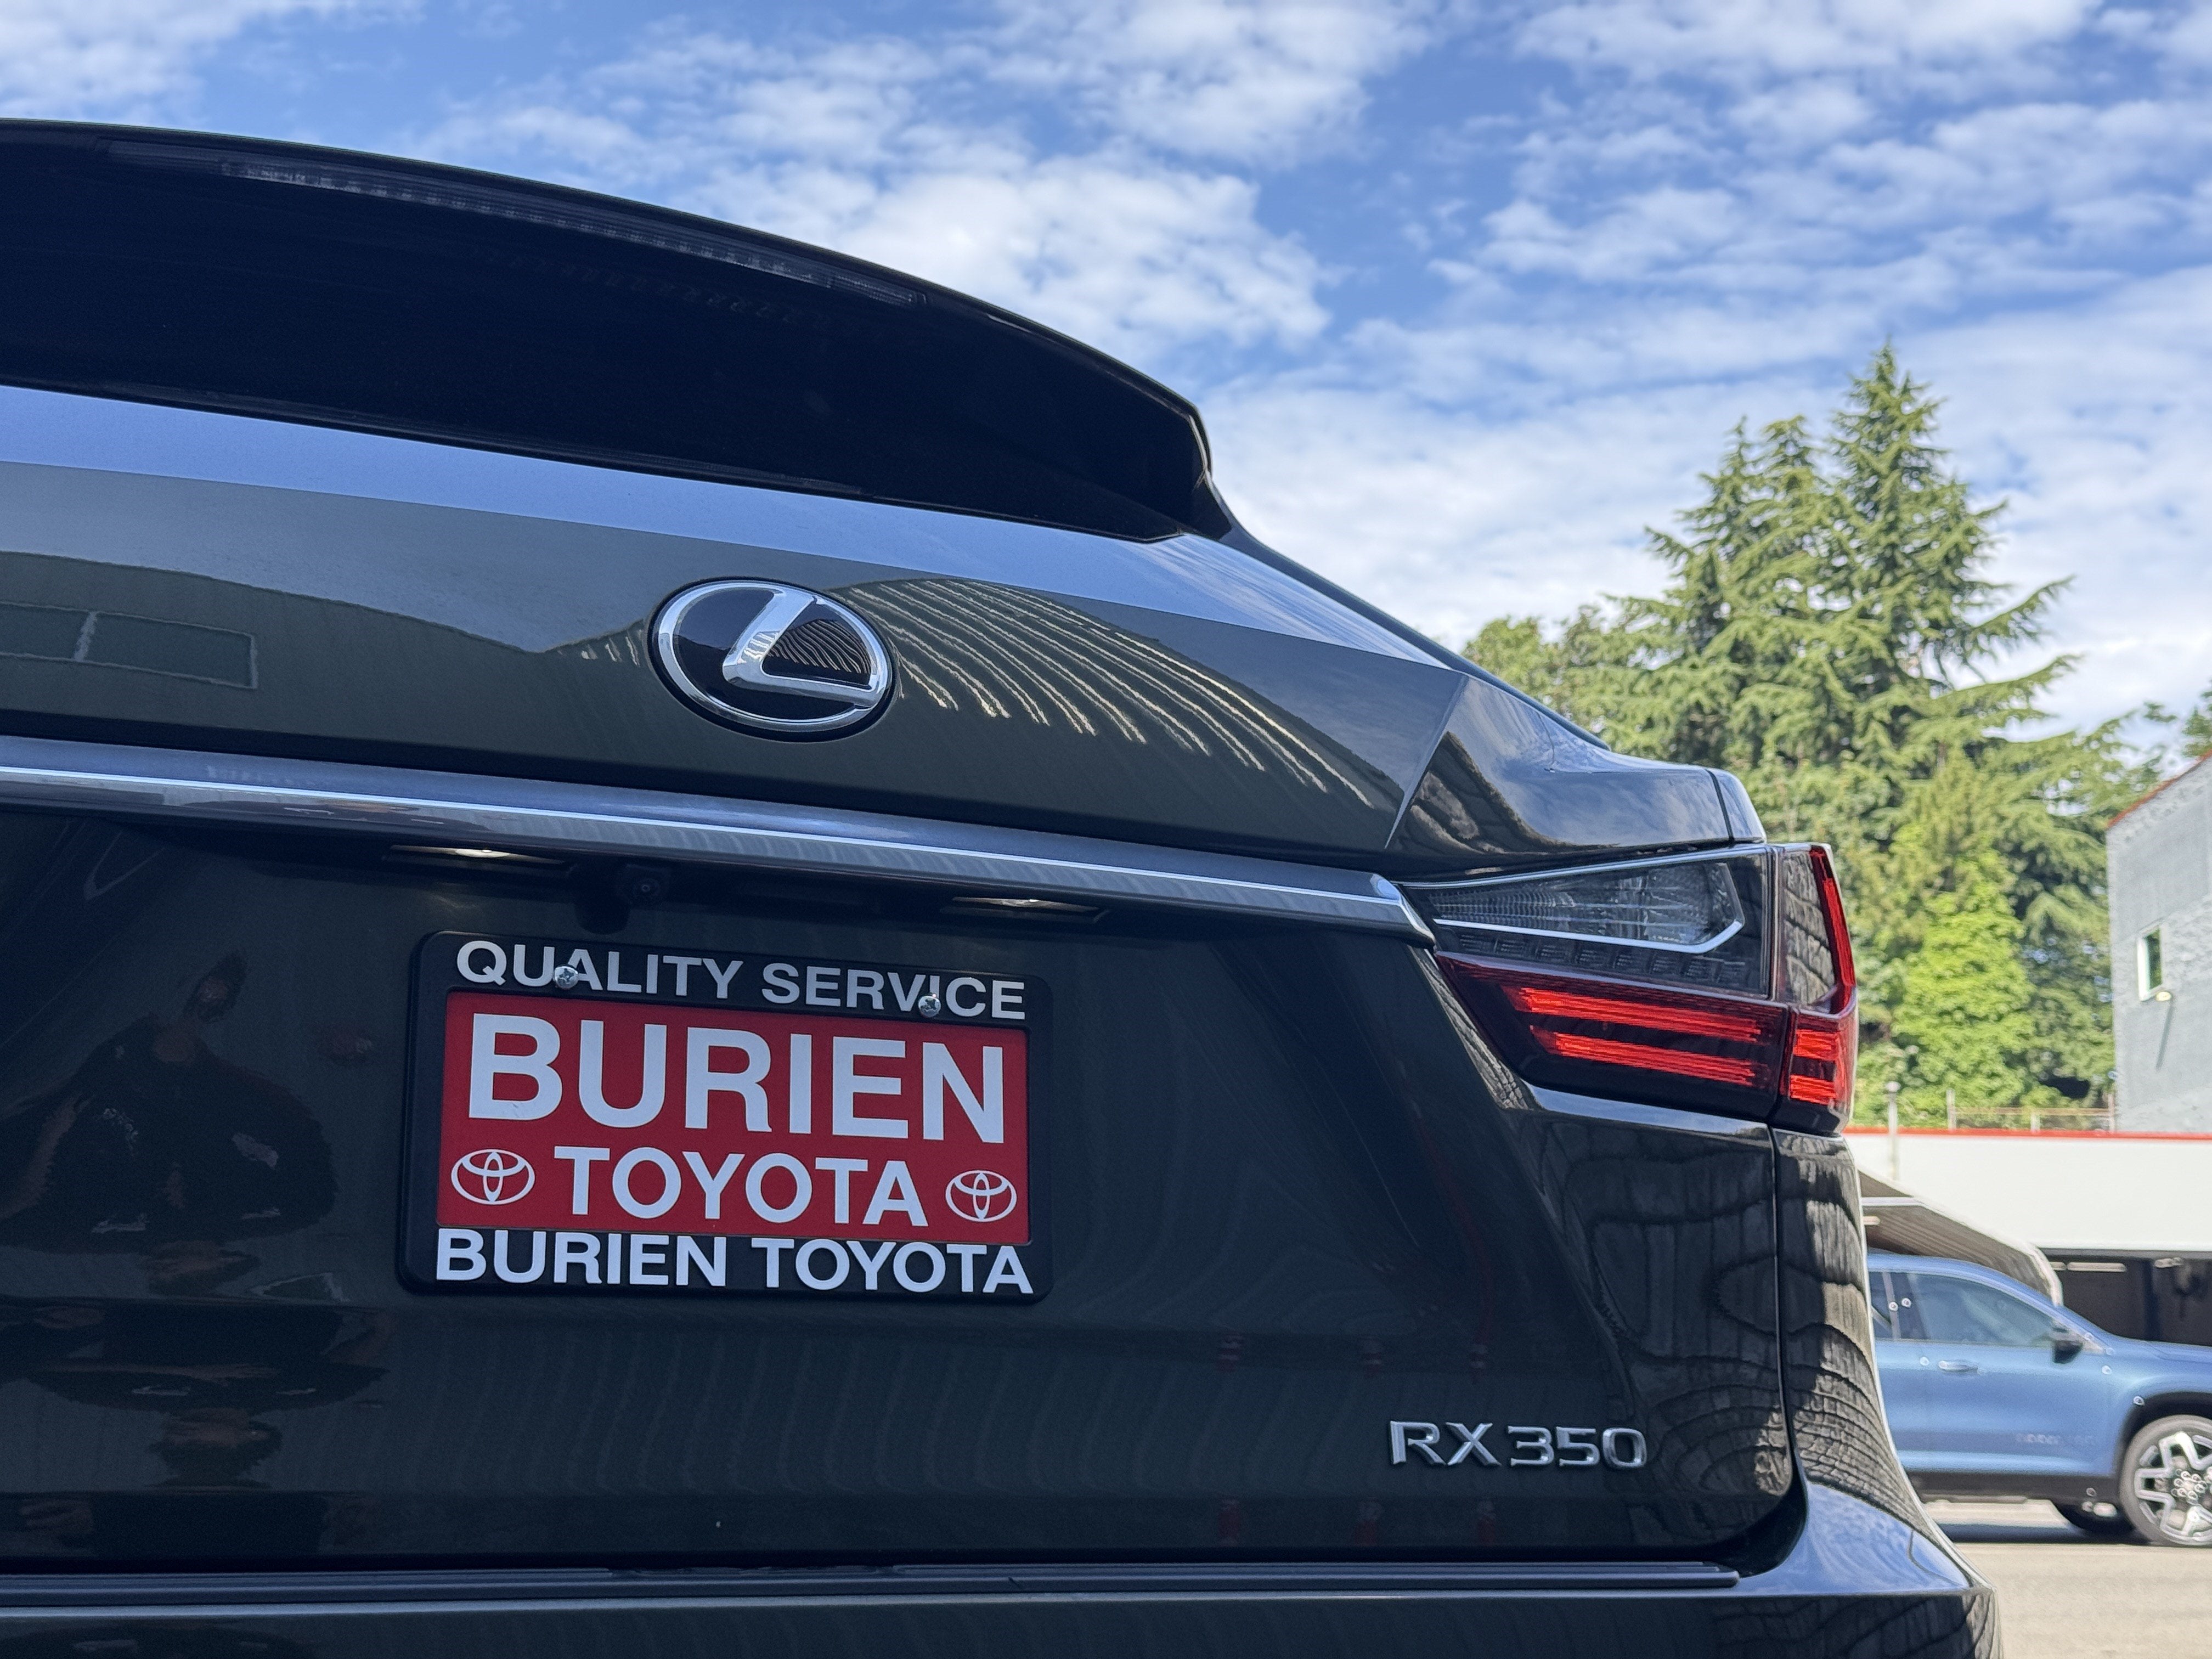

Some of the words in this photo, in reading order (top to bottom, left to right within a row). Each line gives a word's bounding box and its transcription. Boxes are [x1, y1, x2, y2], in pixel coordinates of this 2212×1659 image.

[456, 940, 743, 999] QUALITY
[761, 963, 1025, 1020] SERVICE
[469, 1013, 1004, 1144] BURIEN
[554, 1146, 929, 1227] TOYOTA
[436, 1228, 727, 1287] BURIEN
[752, 1237, 1034, 1294] TOYOTA
[1390, 1420, 1502, 1466] RX
[1508, 1425, 1647, 1468] 350
